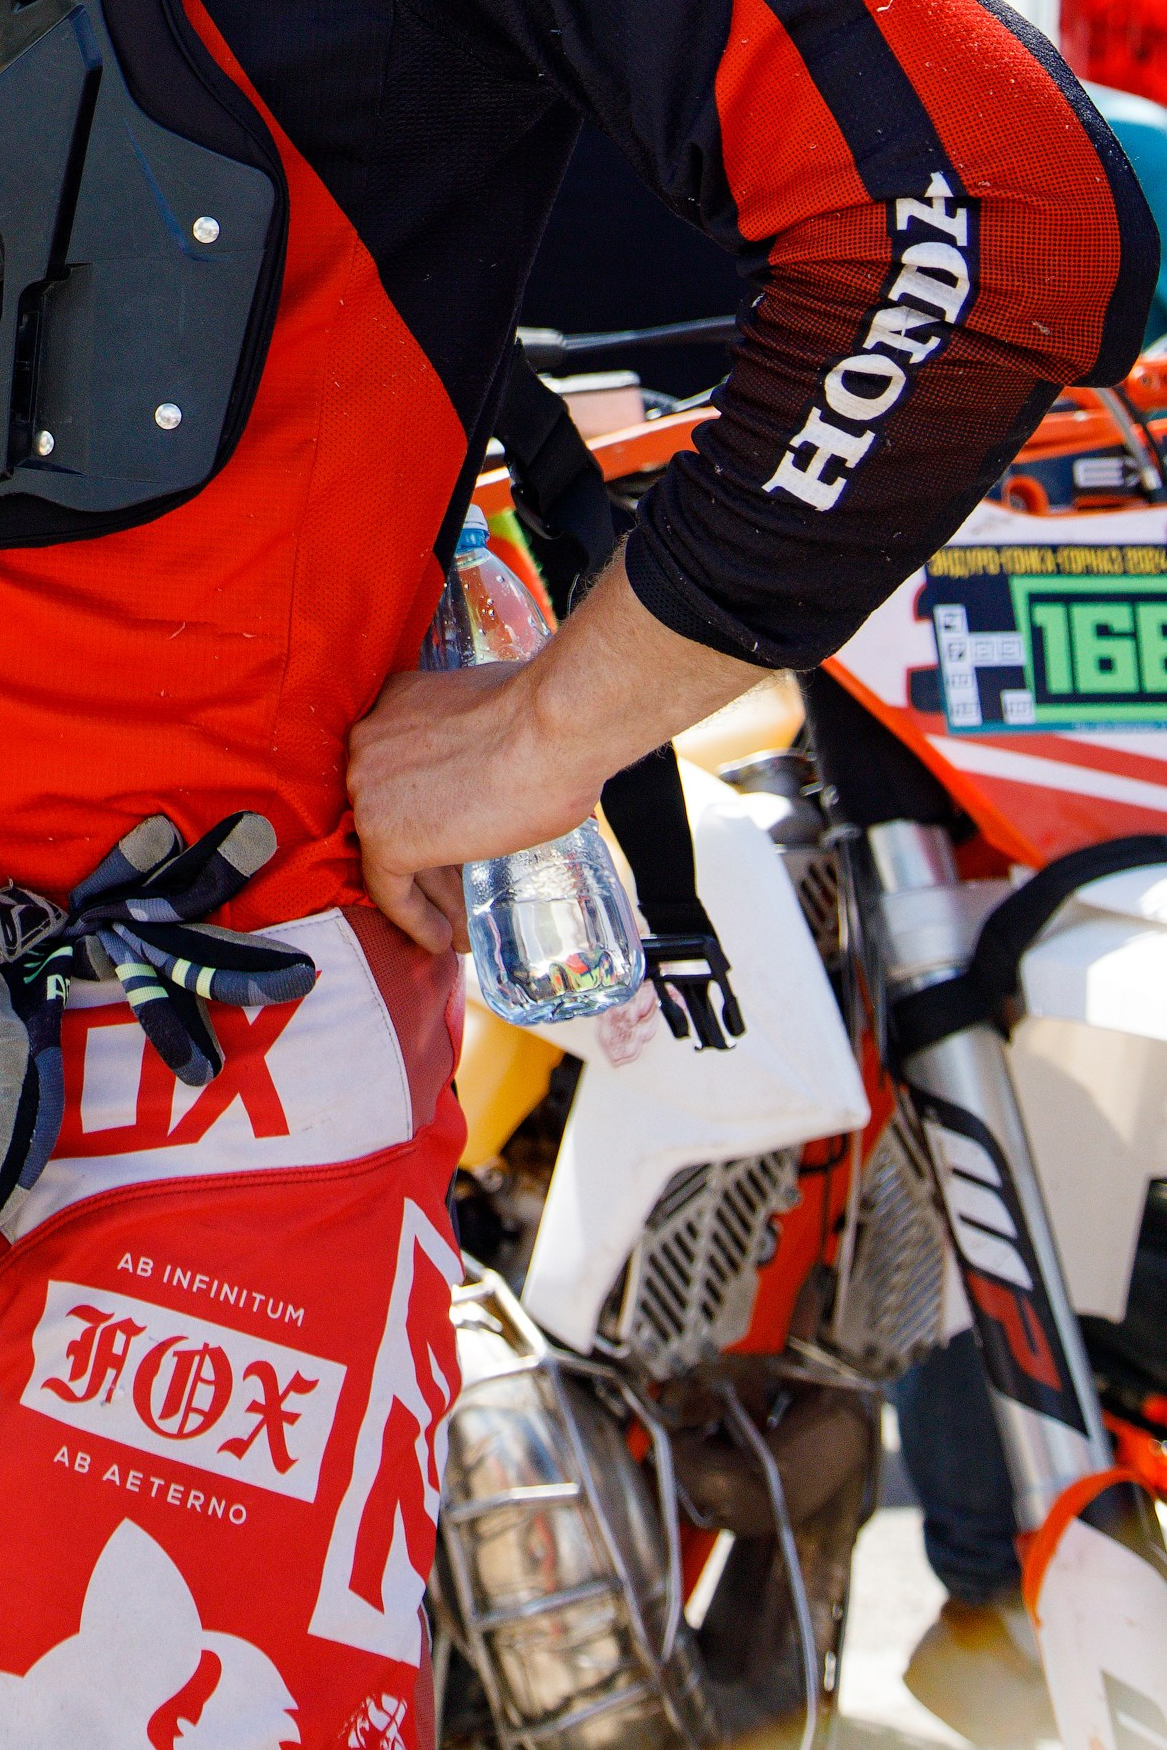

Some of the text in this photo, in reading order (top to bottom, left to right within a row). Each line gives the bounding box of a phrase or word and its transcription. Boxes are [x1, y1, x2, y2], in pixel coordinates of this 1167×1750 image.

[761, 171, 971, 512] HONDA
[116, 1252, 305, 1327] AB INFINITUM
[40, 1304, 320, 1476] FOX
[53, 1446, 248, 1525] AB AETERNO
